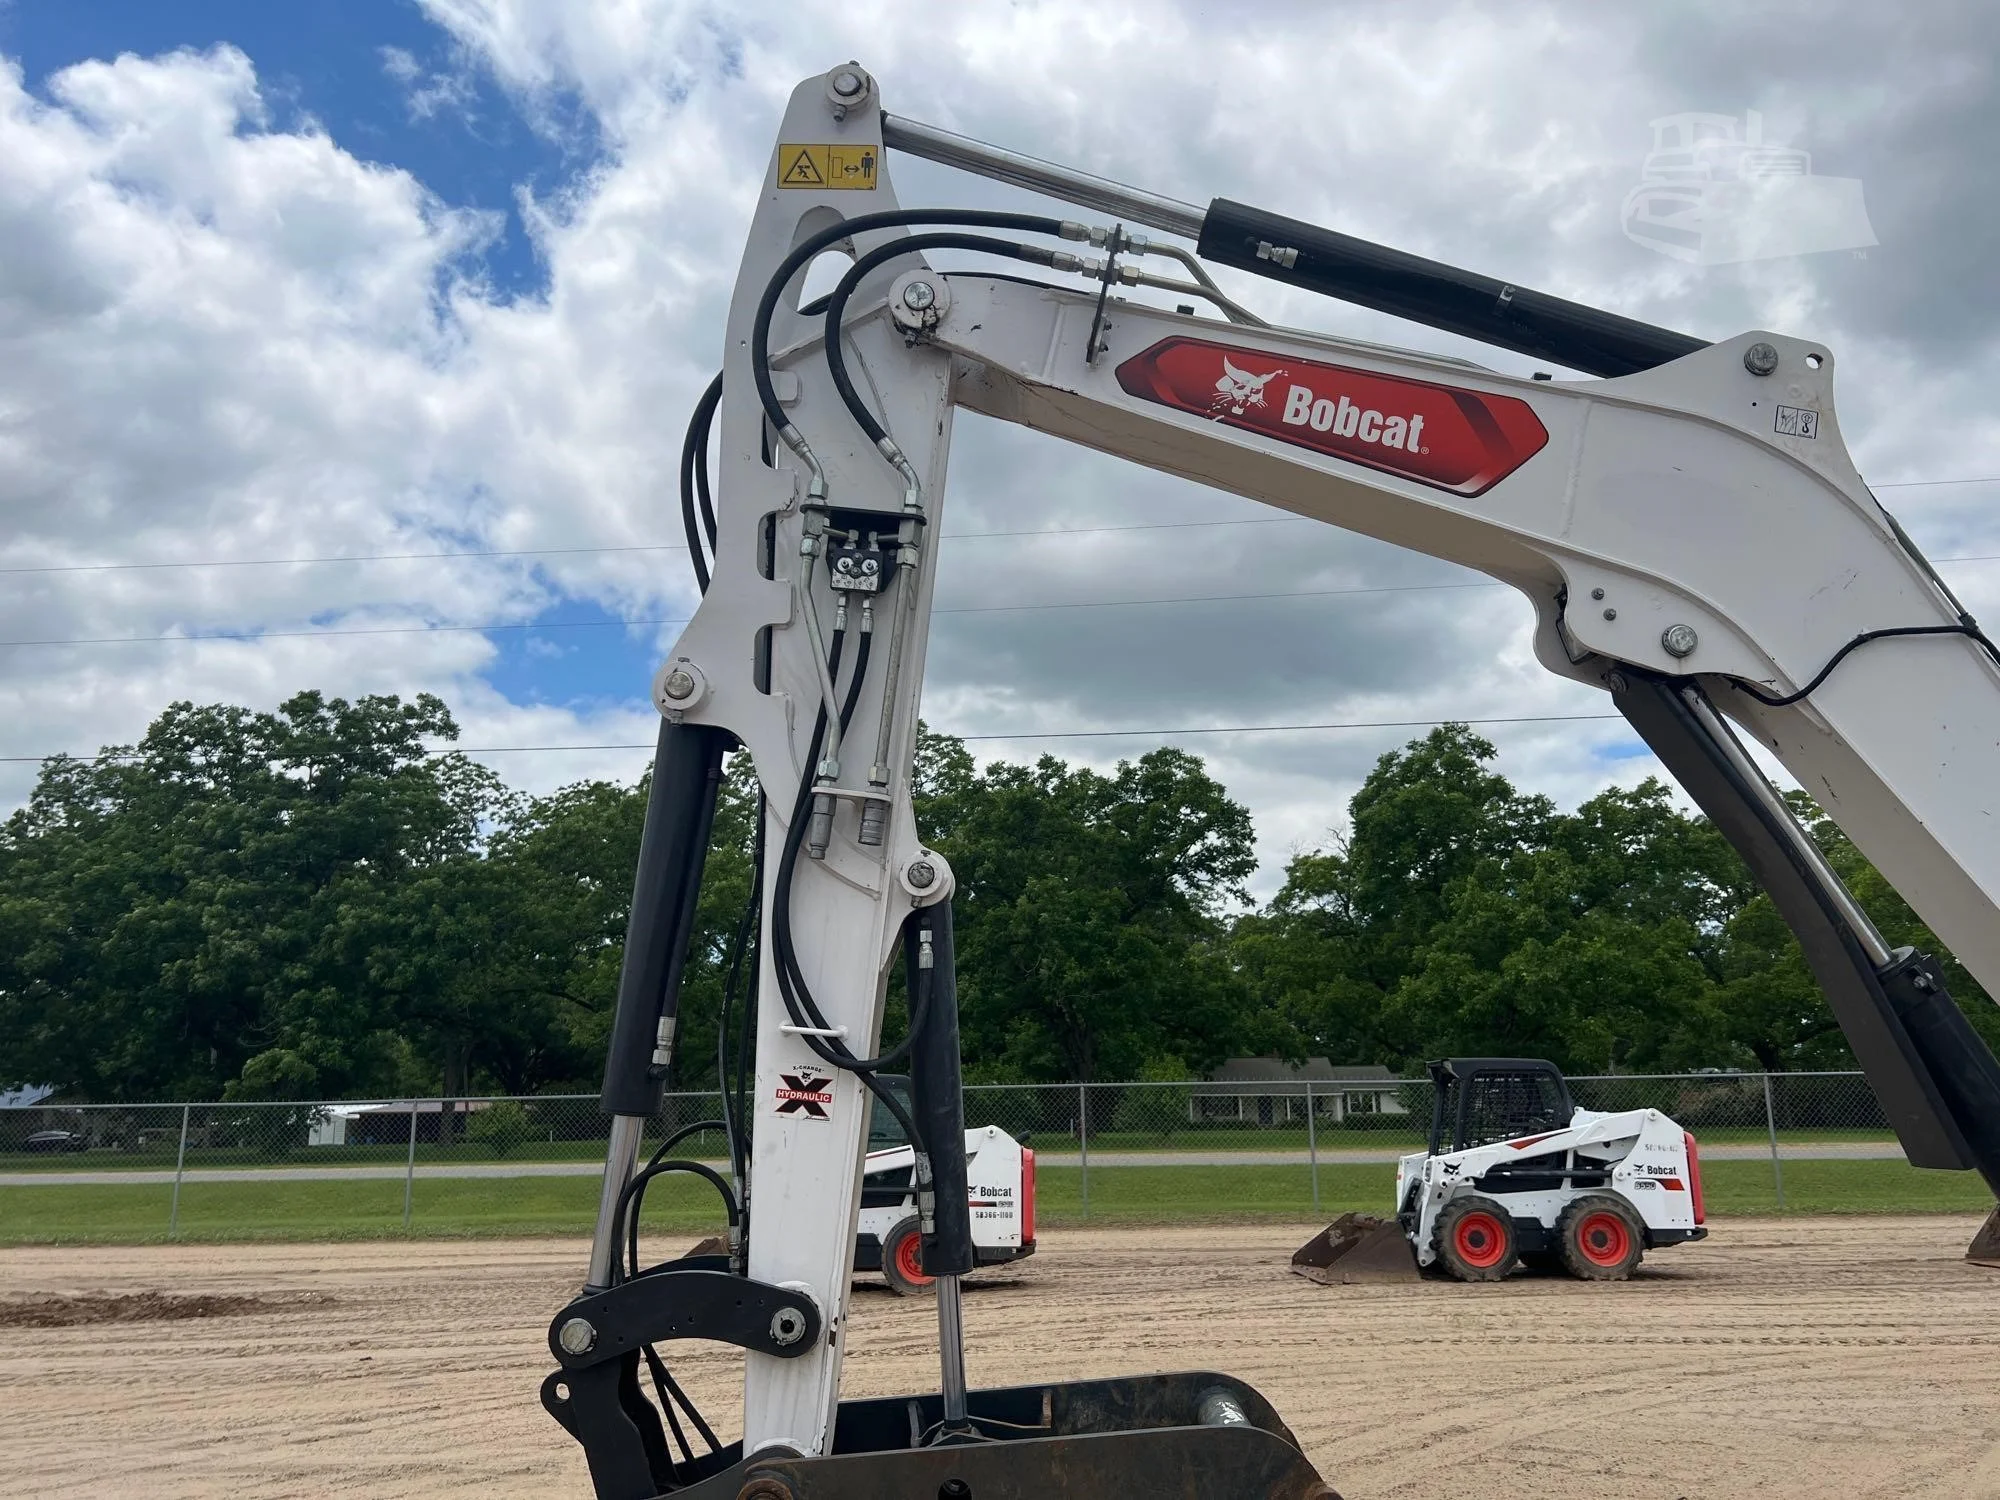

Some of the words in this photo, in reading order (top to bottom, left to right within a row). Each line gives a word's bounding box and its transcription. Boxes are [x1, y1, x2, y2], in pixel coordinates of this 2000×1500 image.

[1282, 384, 1425, 453] Bobcat
[777, 1089, 830, 1102] HYDRAULIC
[1647, 1165, 1677, 1175] Bobcat
[980, 1186, 1012, 1197] Bobcat
